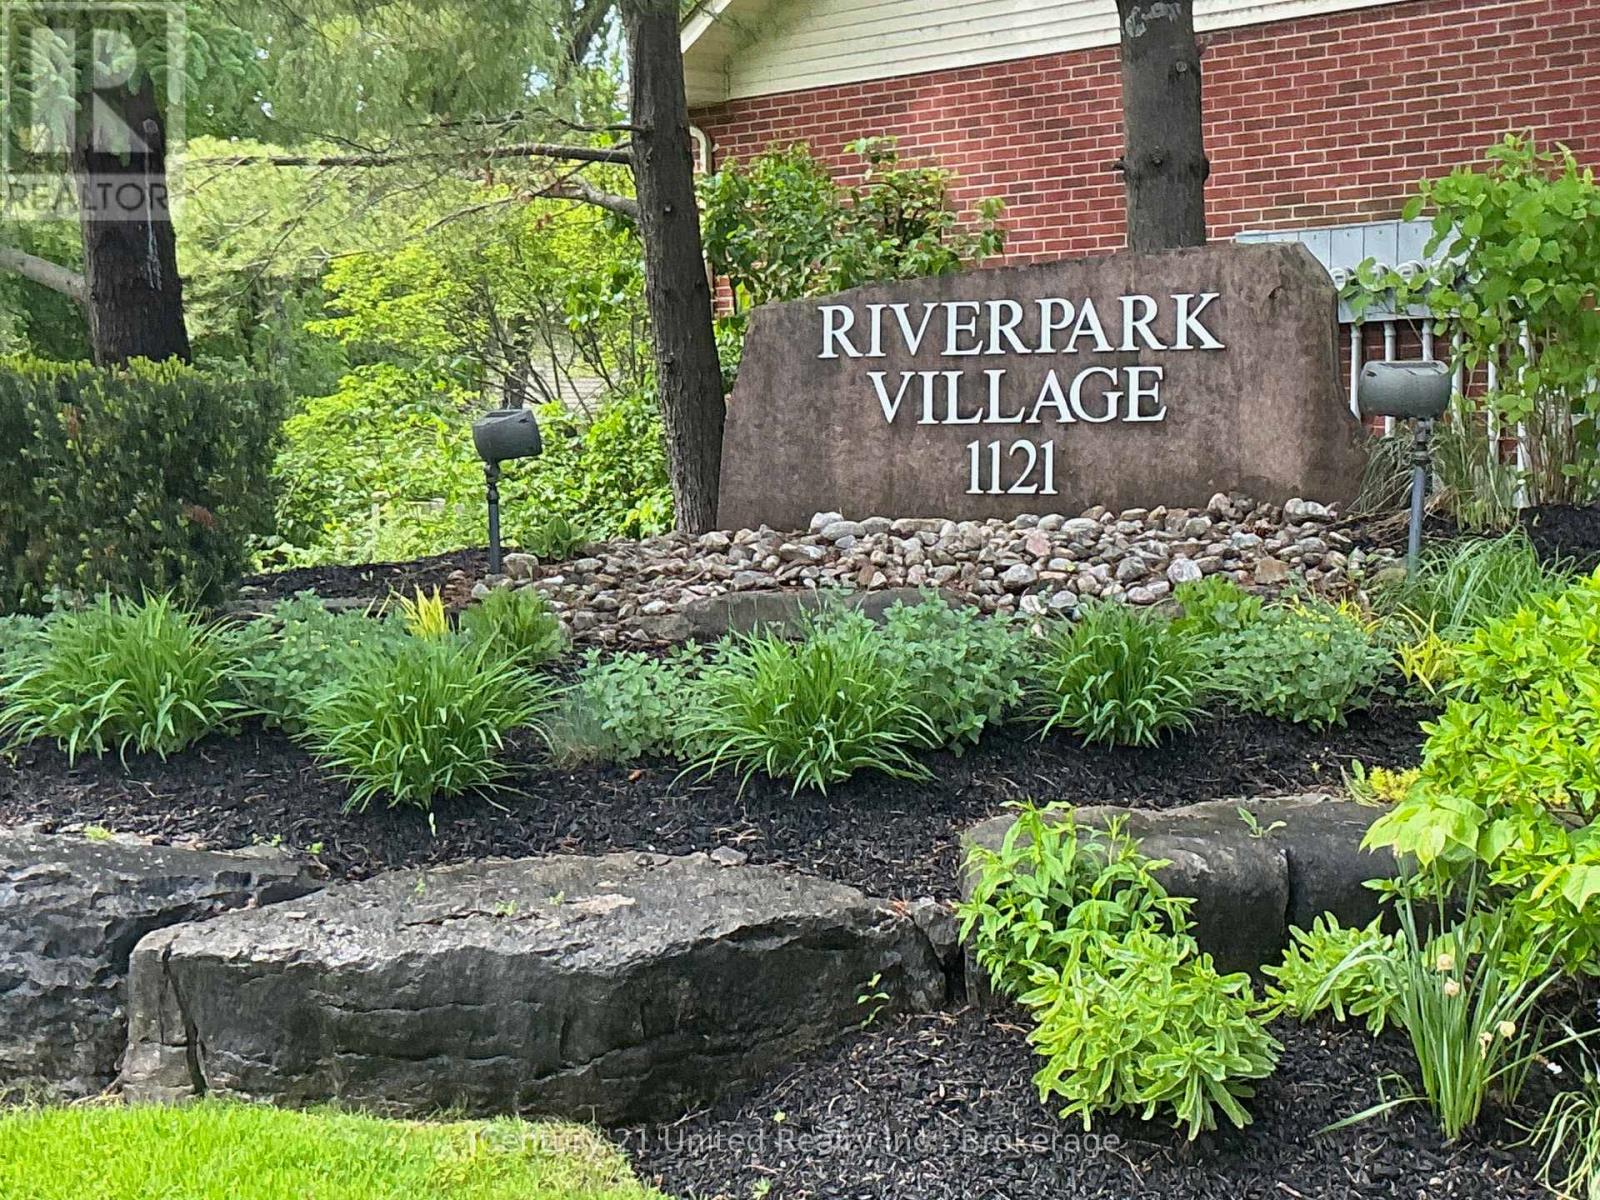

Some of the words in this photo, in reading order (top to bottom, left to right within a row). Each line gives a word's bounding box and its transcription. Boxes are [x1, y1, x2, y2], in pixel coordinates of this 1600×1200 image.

[818, 292, 1225, 359] RIVERPARK
[867, 366, 1167, 424] VILLAGE
[966, 439, 1058, 496] 1121
